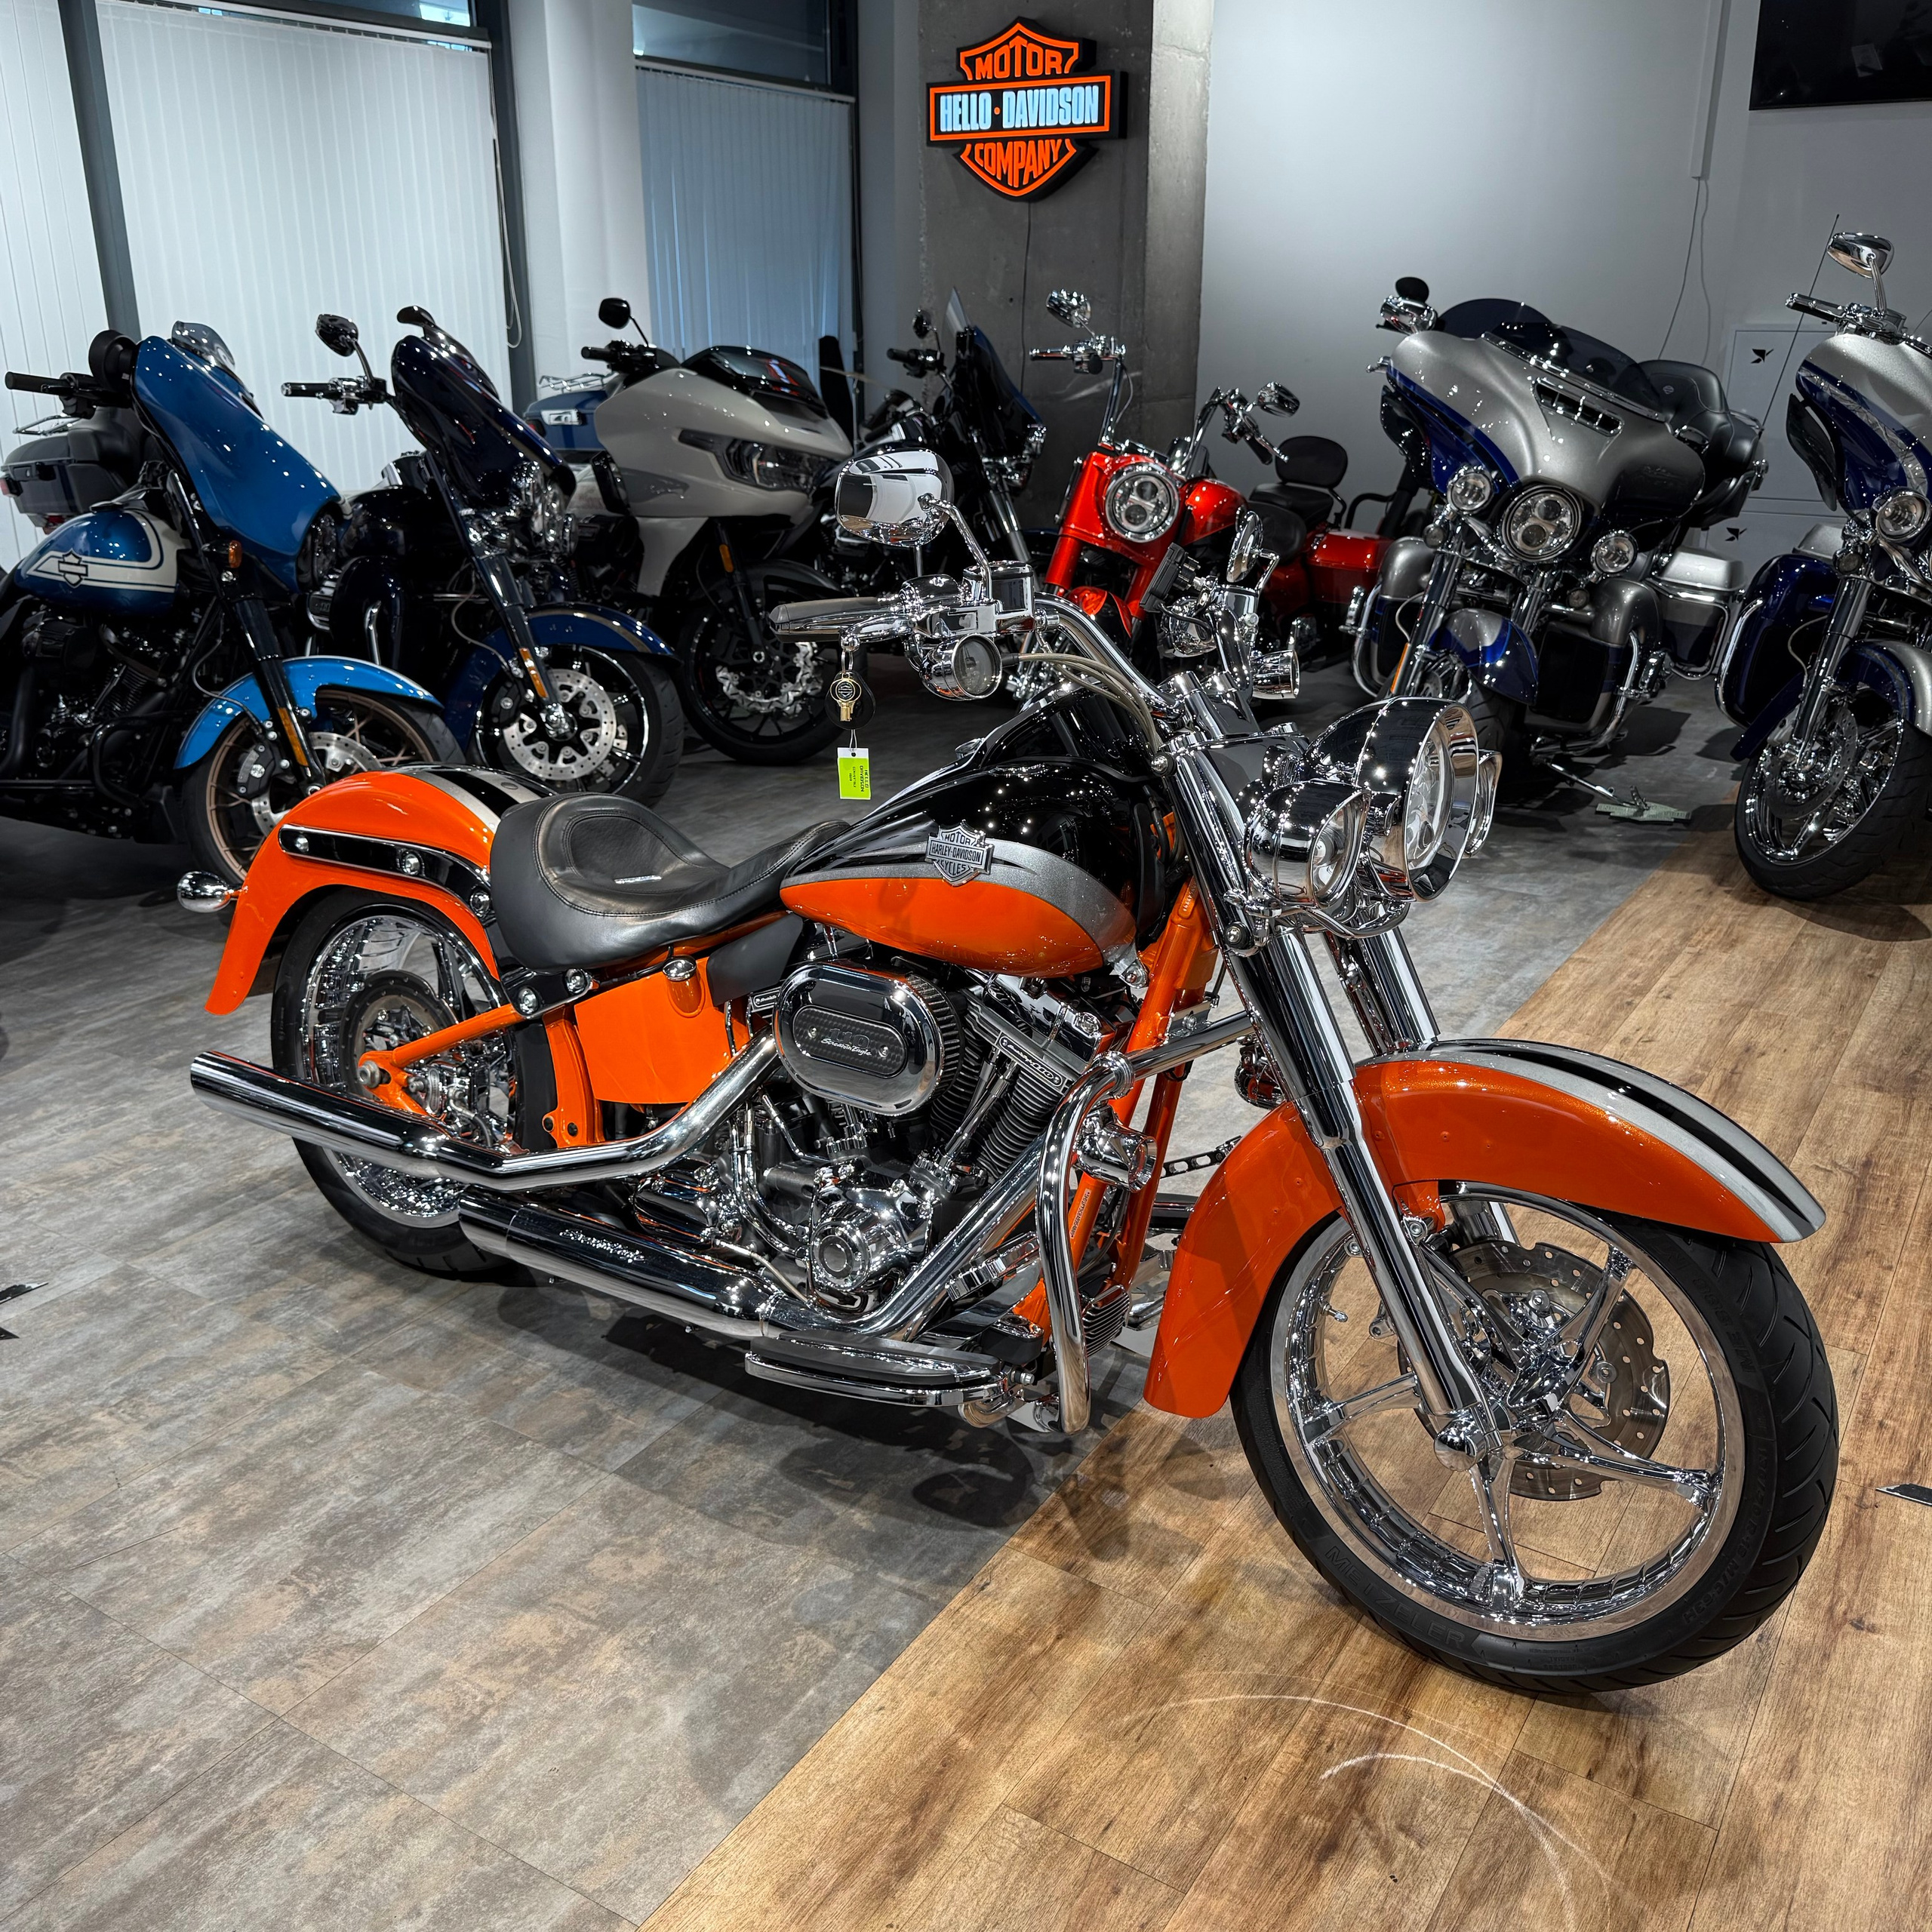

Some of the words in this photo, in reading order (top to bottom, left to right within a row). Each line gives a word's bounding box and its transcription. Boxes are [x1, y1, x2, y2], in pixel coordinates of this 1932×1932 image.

[975, 35, 1063, 80] MOTOR
[940, 92, 992, 132] HELLO
[1003, 85, 1099, 128] DAVIDSON
[974, 139, 1063, 188] COMPANY
[931, 843, 981, 863] HARLEY-DAVIDSON
[944, 831, 971, 845] MOTOR
[940, 860, 967, 875] CYCLES
[829, 1028, 870, 1049] 110
[1324, 1545, 1466, 1650] METZELER
